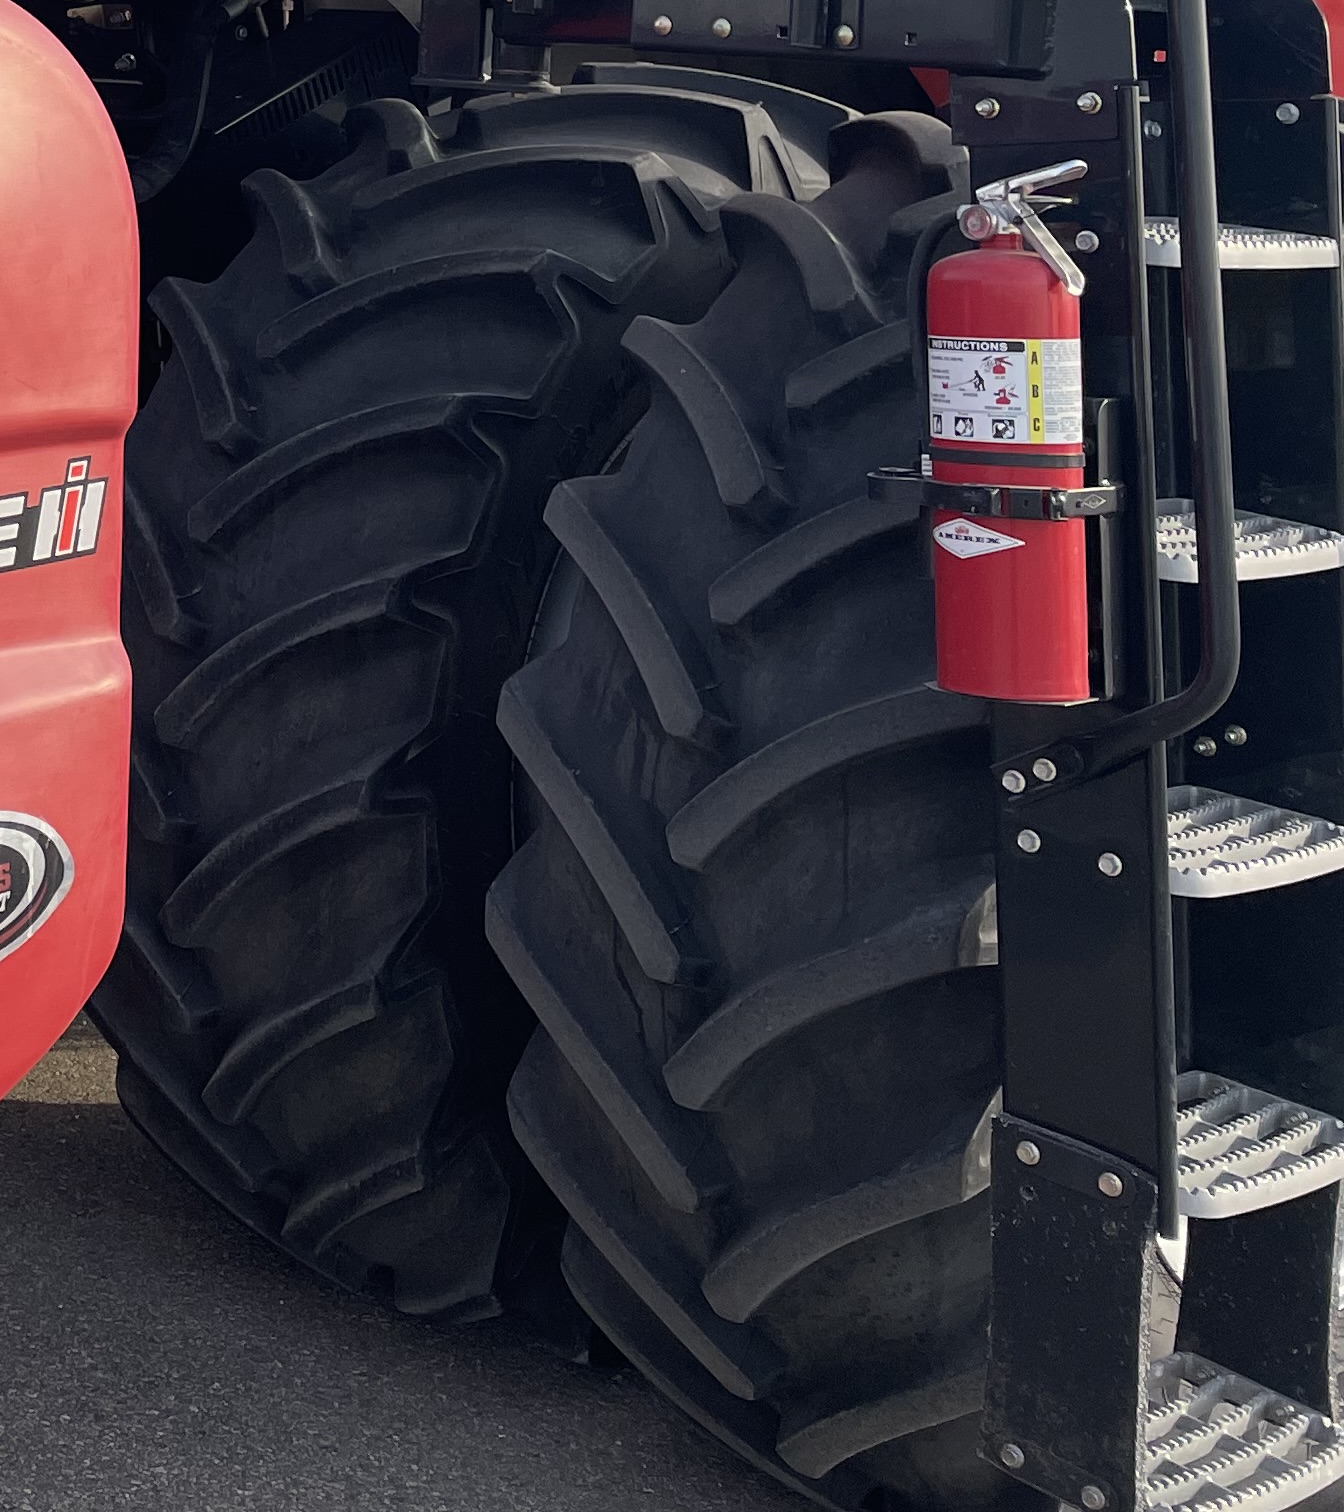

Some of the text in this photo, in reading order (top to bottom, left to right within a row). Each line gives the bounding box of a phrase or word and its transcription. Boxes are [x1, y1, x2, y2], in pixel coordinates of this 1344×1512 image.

[1030, 351, 1039, 366] A
[1031, 384, 1040, 399] B
[1032, 417, 1041, 433] C
[937, 531, 1001, 545] AMEREX
